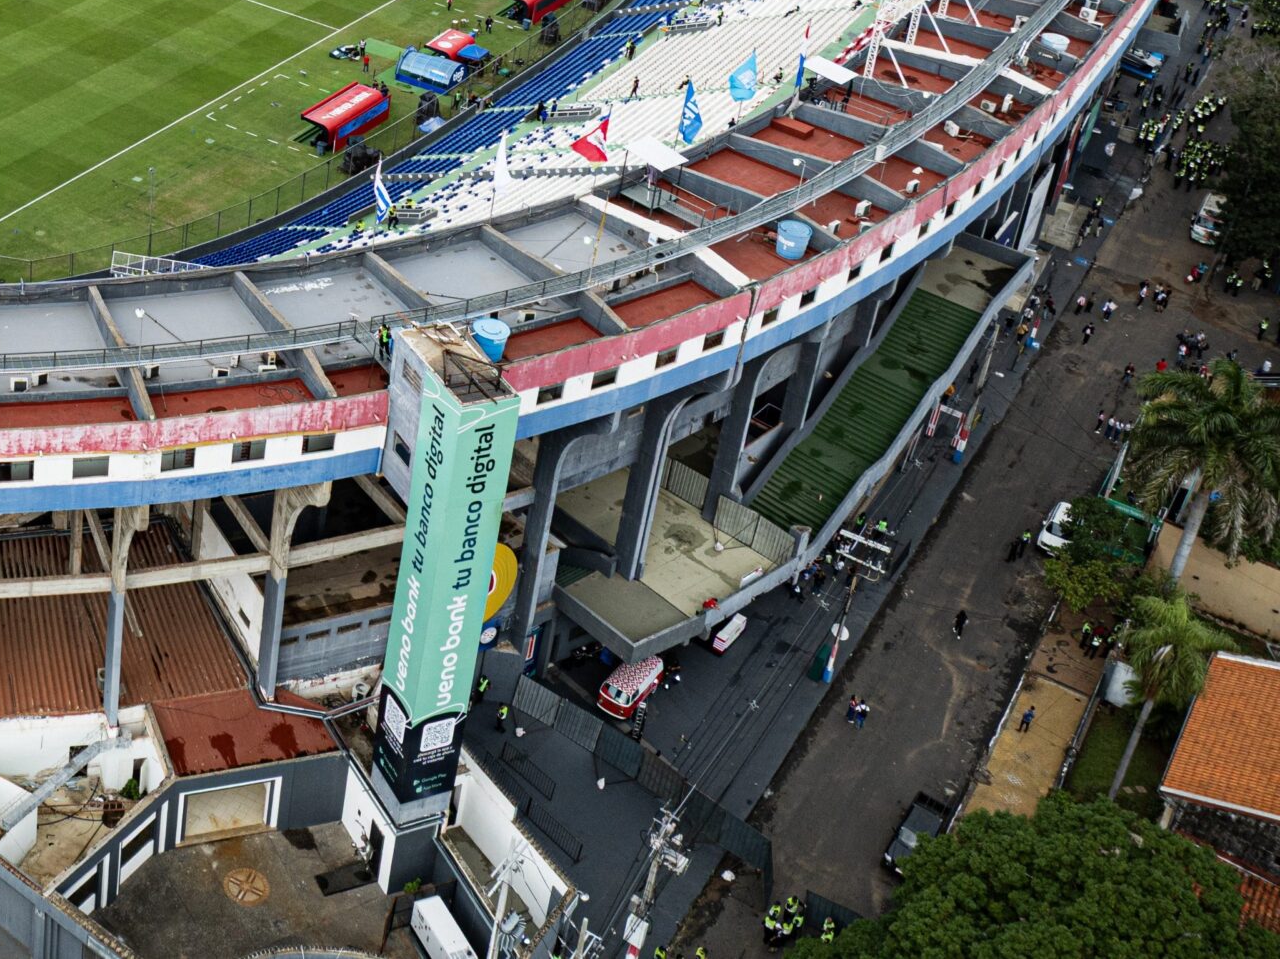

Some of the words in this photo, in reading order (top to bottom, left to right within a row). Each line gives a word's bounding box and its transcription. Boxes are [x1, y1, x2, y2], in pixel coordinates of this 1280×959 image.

[425, 404, 445, 481] digital
[466, 423, 496, 495] digital
[414, 483, 434, 549] banco
[454, 500, 483, 564] banco
[411, 549, 424, 574] tu
[452, 568, 472, 590] tu
[401, 575, 420, 634] bank
[440, 594, 468, 652] bank
[396, 635, 411, 692] ueno
[436, 653, 458, 707] ueno
